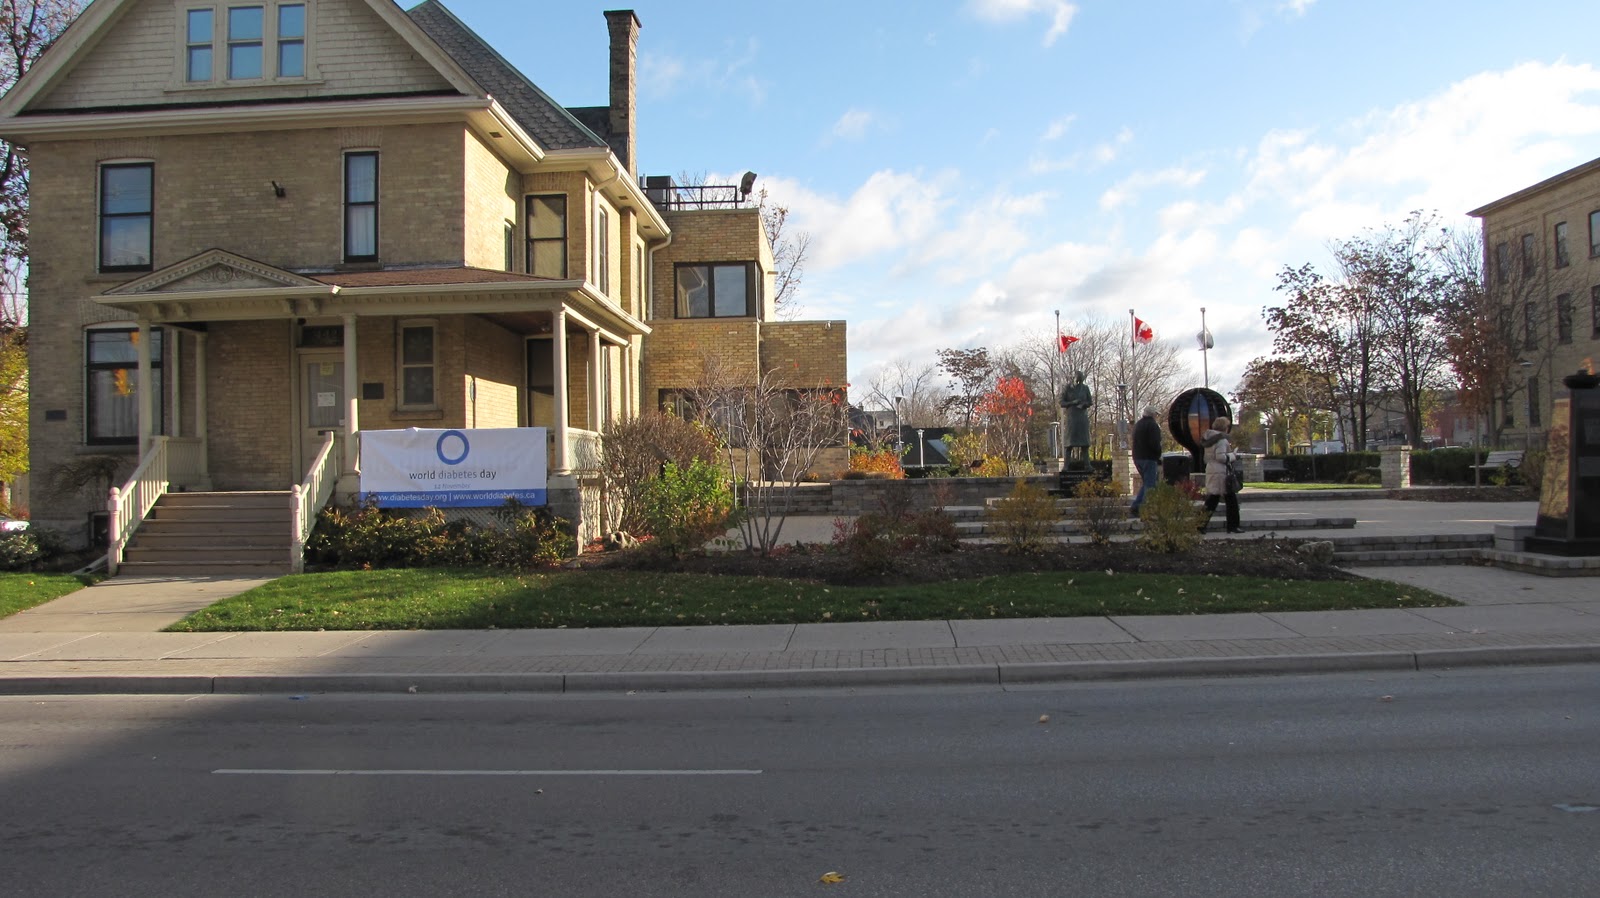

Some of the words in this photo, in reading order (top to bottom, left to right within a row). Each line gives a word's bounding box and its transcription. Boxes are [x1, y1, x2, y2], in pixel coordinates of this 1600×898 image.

[409, 470, 435, 480] world
[438, 470, 477, 479] diabetes
[480, 469, 497, 480] day
